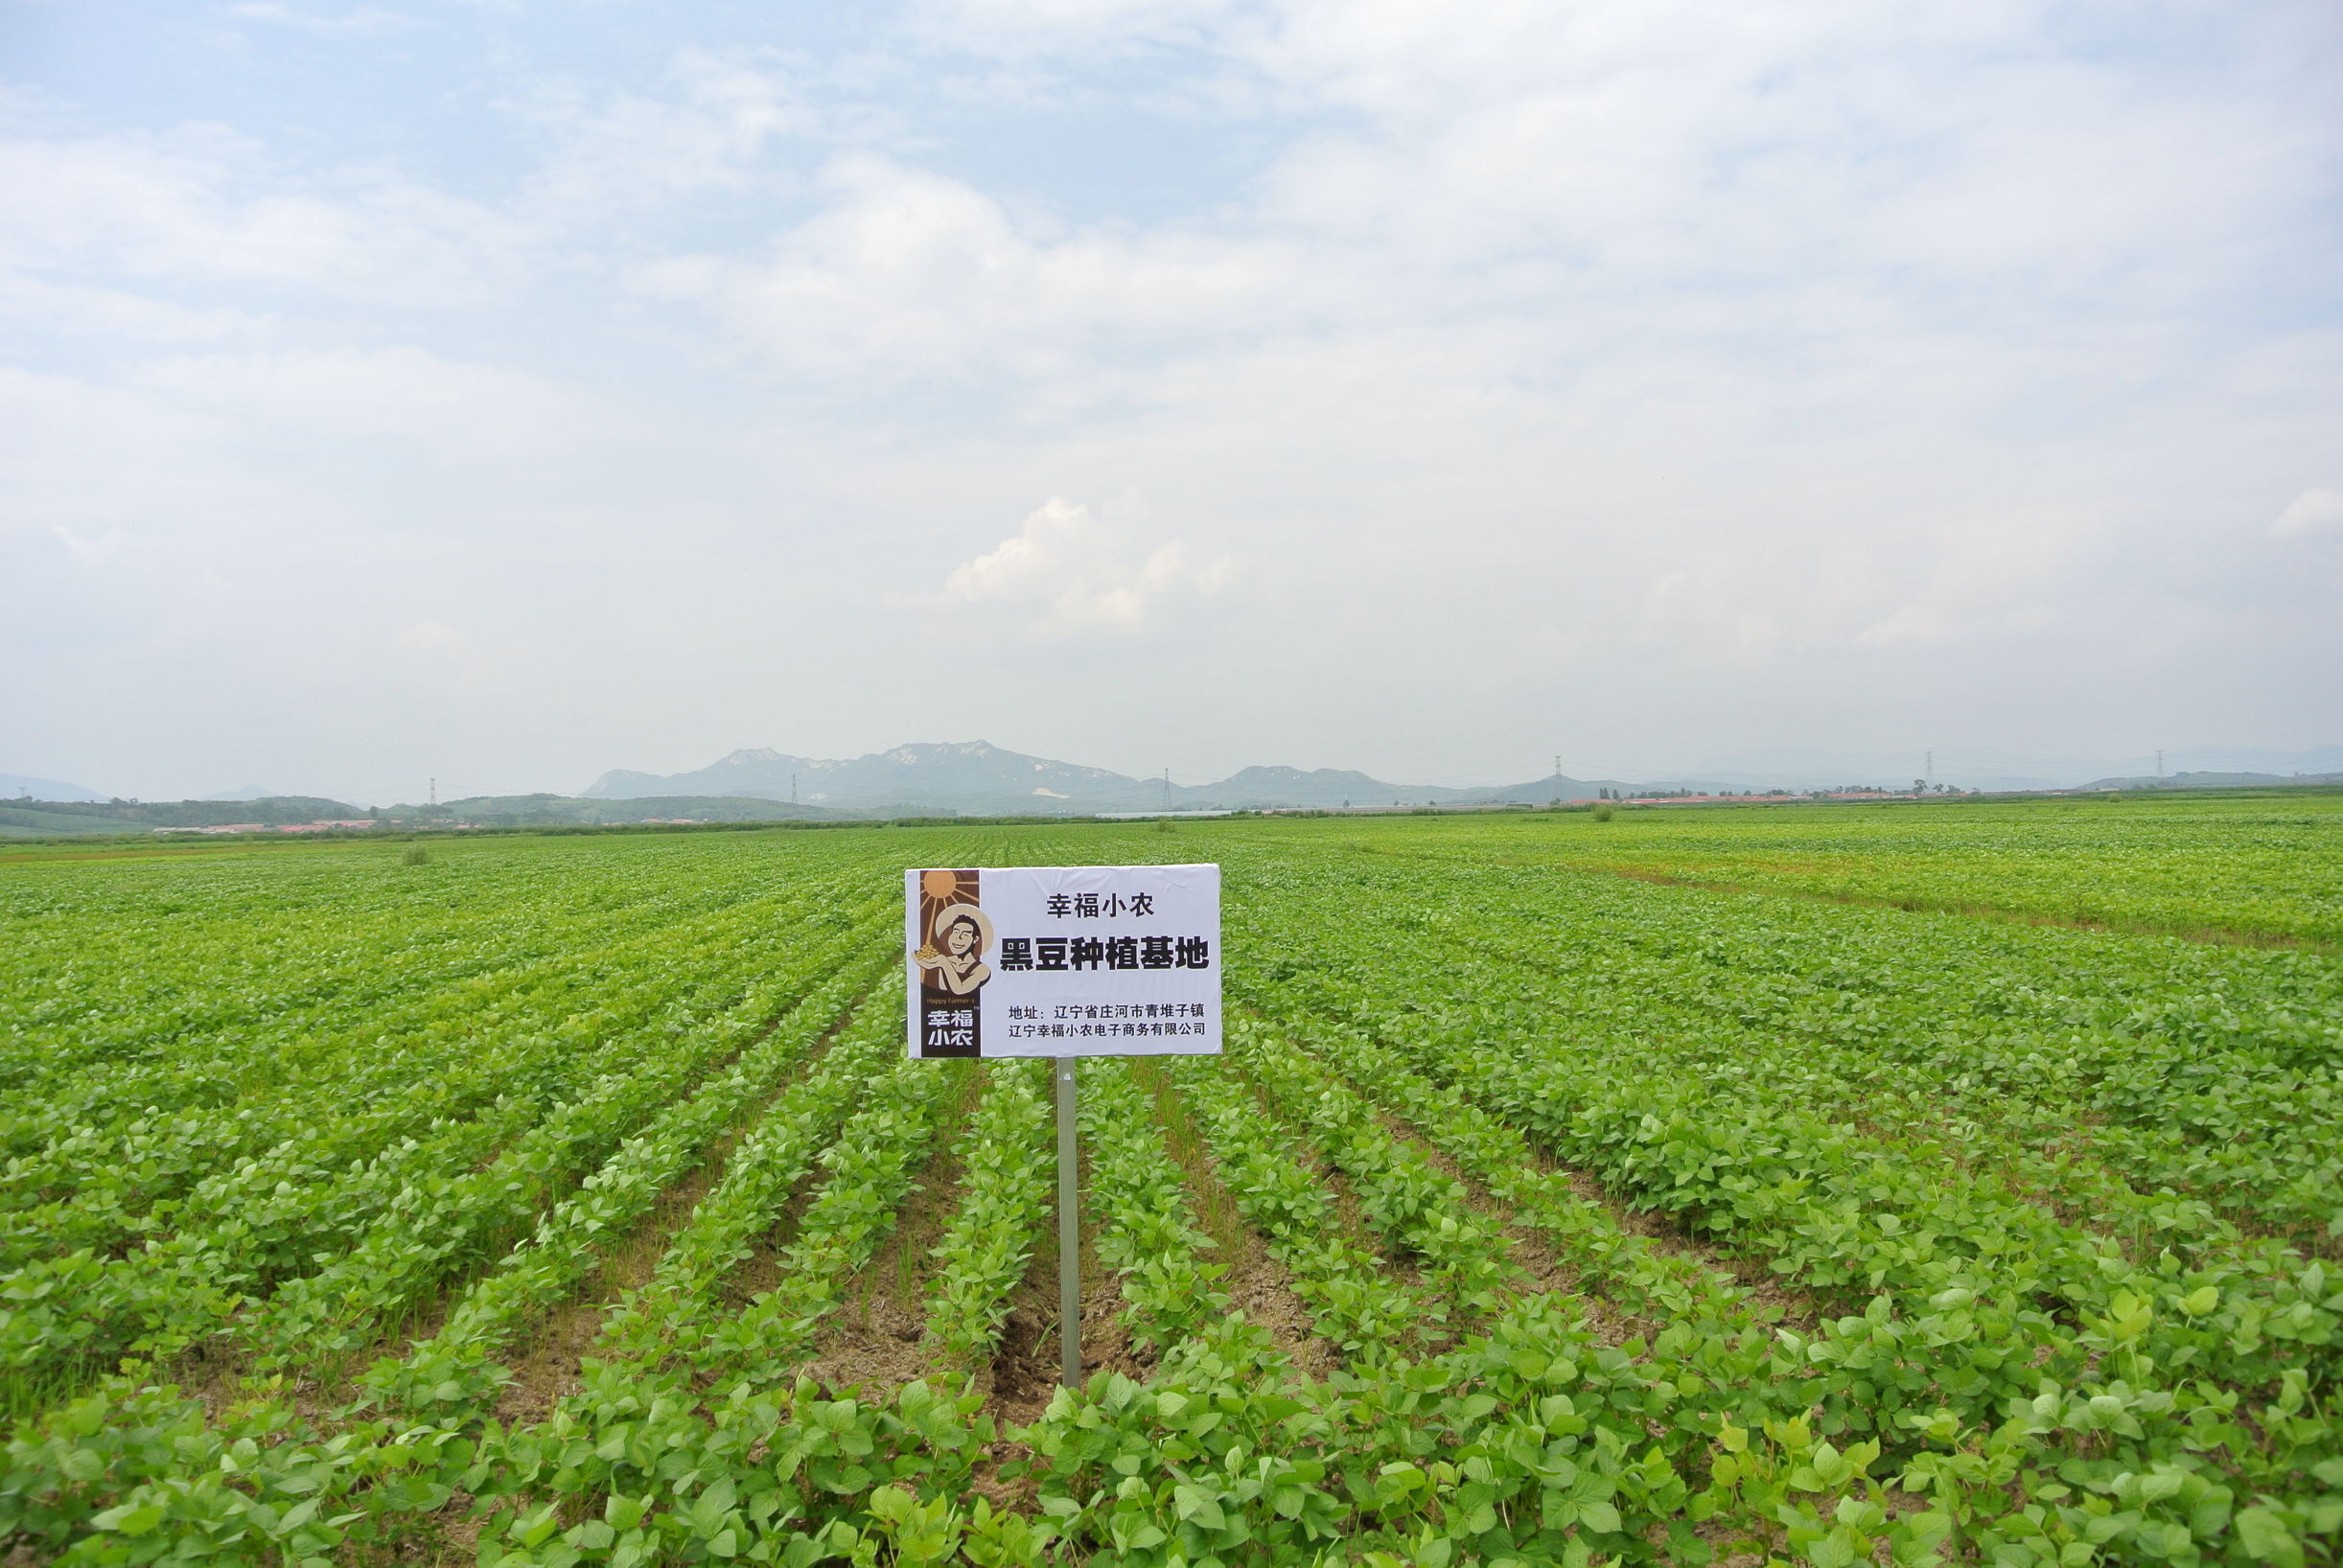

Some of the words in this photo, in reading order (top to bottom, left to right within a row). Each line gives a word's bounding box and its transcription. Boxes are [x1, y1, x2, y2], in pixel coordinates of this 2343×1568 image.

[1047, 892, 1155, 919] 幸福小农
[999, 935, 1210, 971] 黑豆种植基地
[927, 1009, 973, 1027] 幸福
[928, 1028, 973, 1046] 小农
[1009, 1023, 1206, 1038] 辽宁幸福小农电子商务有限公司
